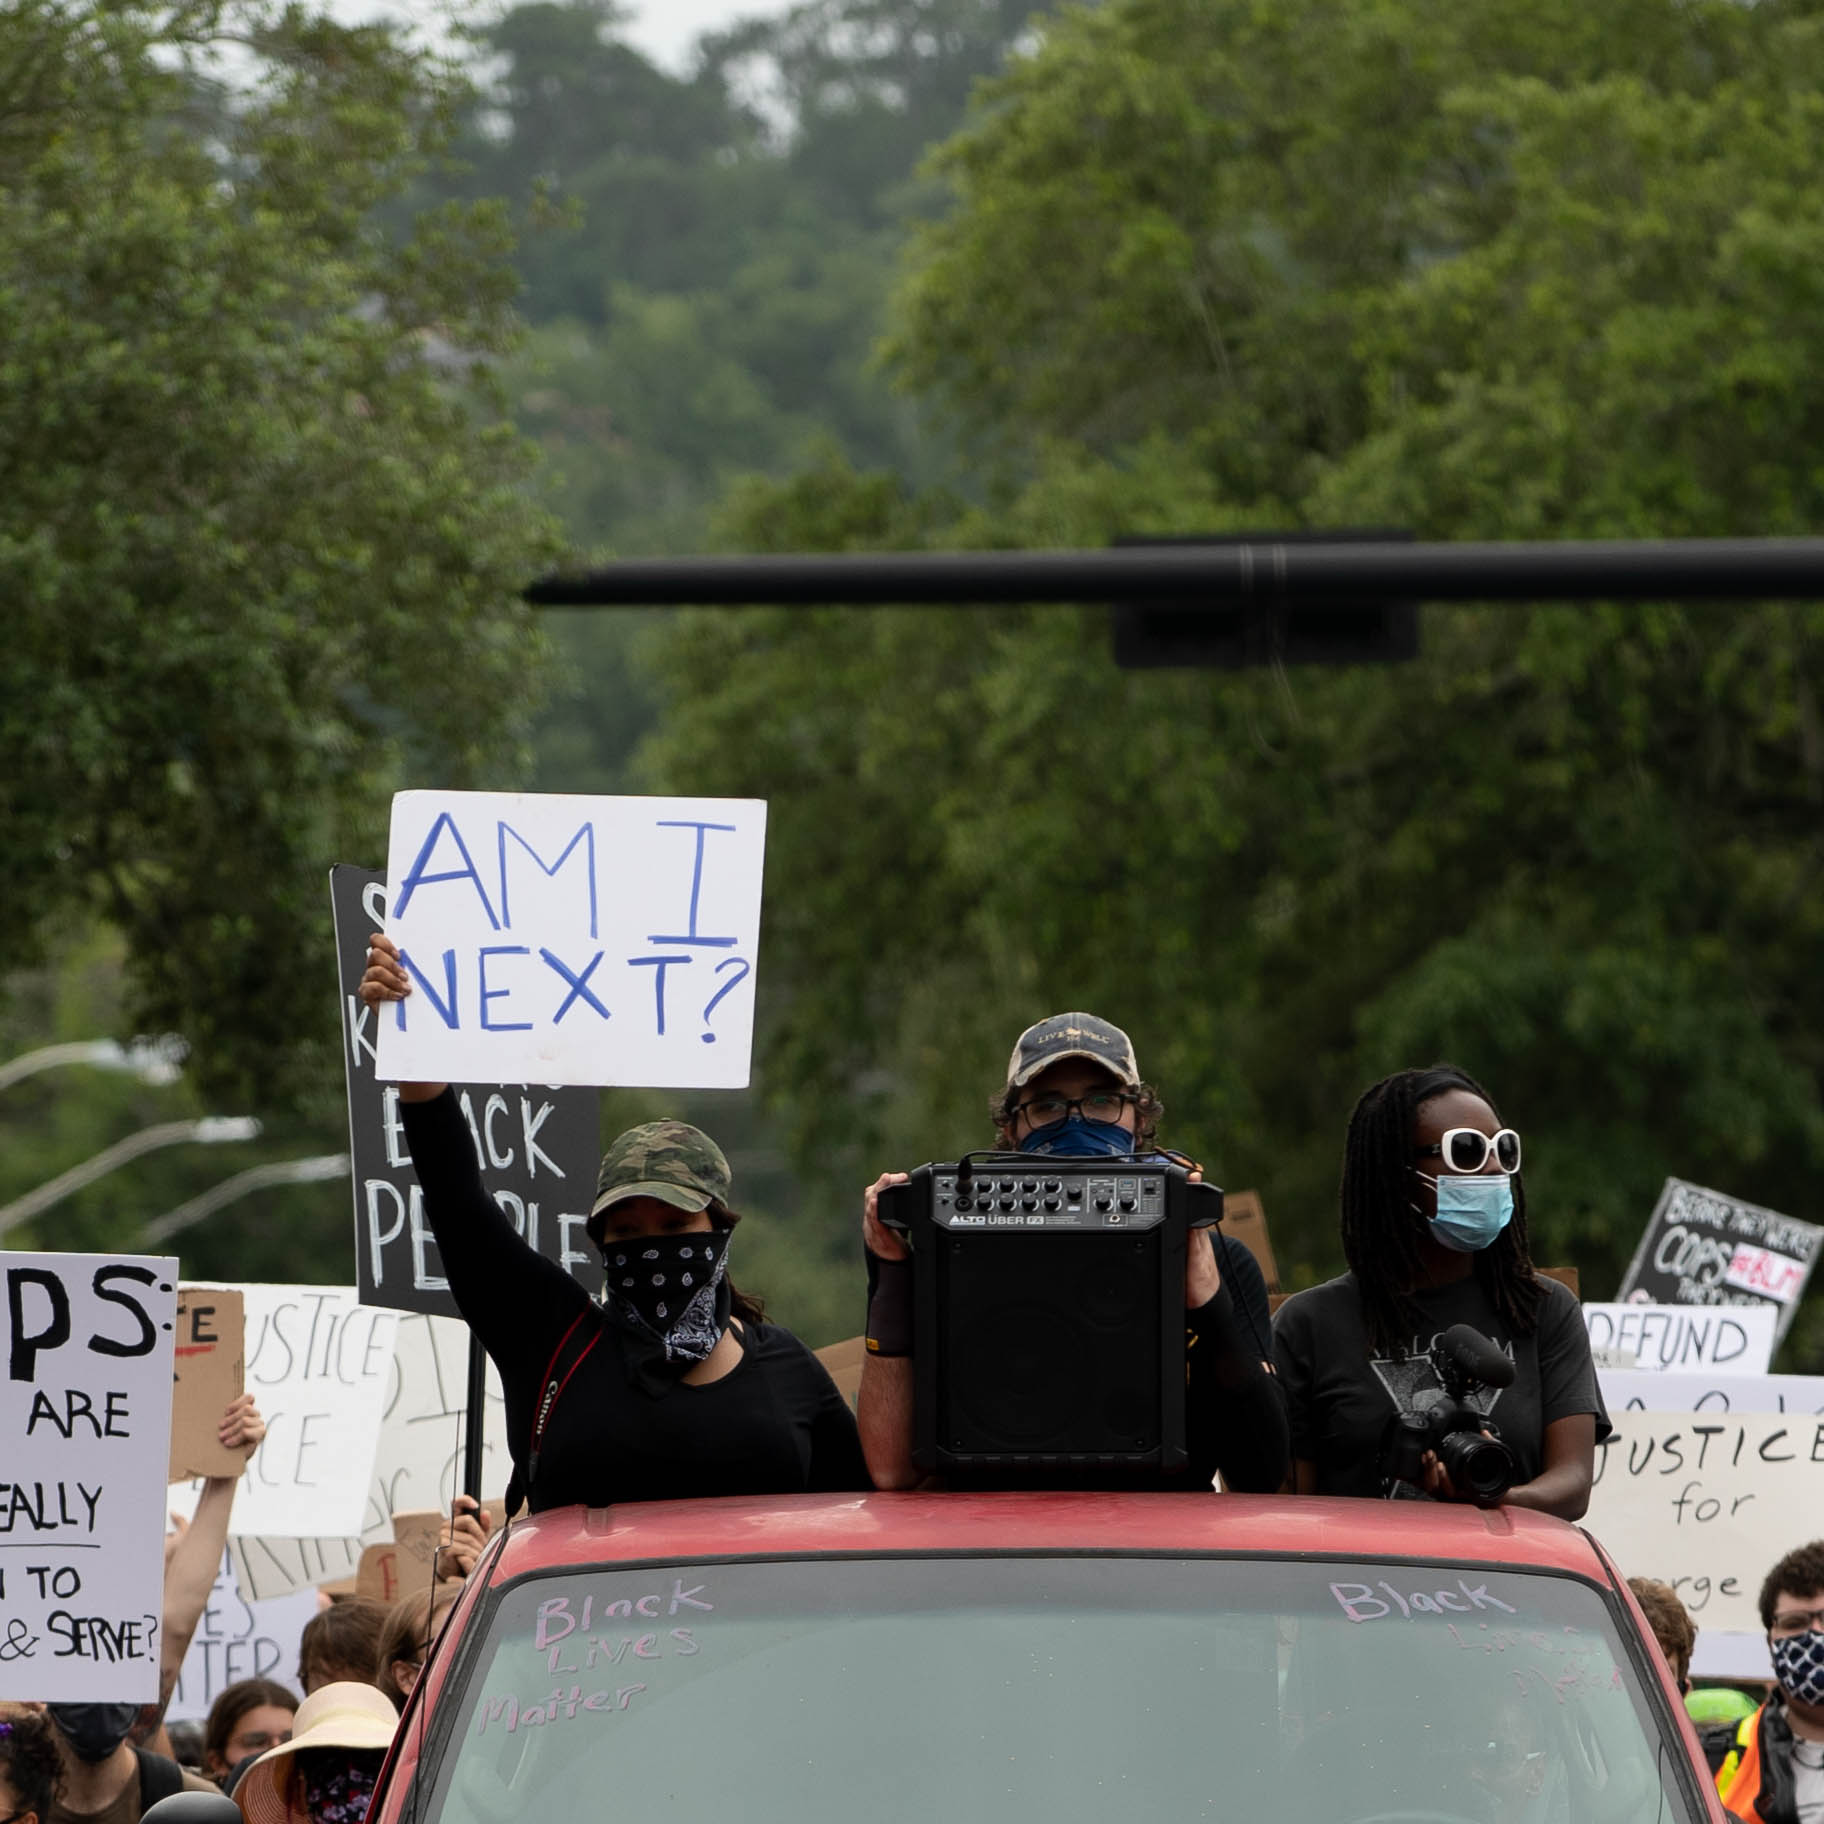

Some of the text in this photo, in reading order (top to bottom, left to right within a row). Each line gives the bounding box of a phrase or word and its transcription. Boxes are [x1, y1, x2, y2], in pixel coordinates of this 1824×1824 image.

[393, 811, 739, 947] AM I
[395, 943, 751, 1045] NEXT?
[382, 1086, 566, 1180] BCK
[949, 1215, 987, 1226] ALTO
[1653, 1225, 1733, 1288] COPS
[1587, 1311, 1749, 1370] DEFUND
[26, 1390, 131, 1440] ARE
[536, 1380, 559, 1435] Canon
[1671, 1480, 1757, 1526] for
[27, 1565, 82, 1600] TO
[1328, 1579, 1518, 1624] Black
[45, 1610, 159, 1665] SERVE?
[203, 1586, 256, 1640] ES
[534, 1578, 715, 1651] Black
[547, 1626, 701, 1675] Lives
[477, 1684, 648, 1735] Matter
